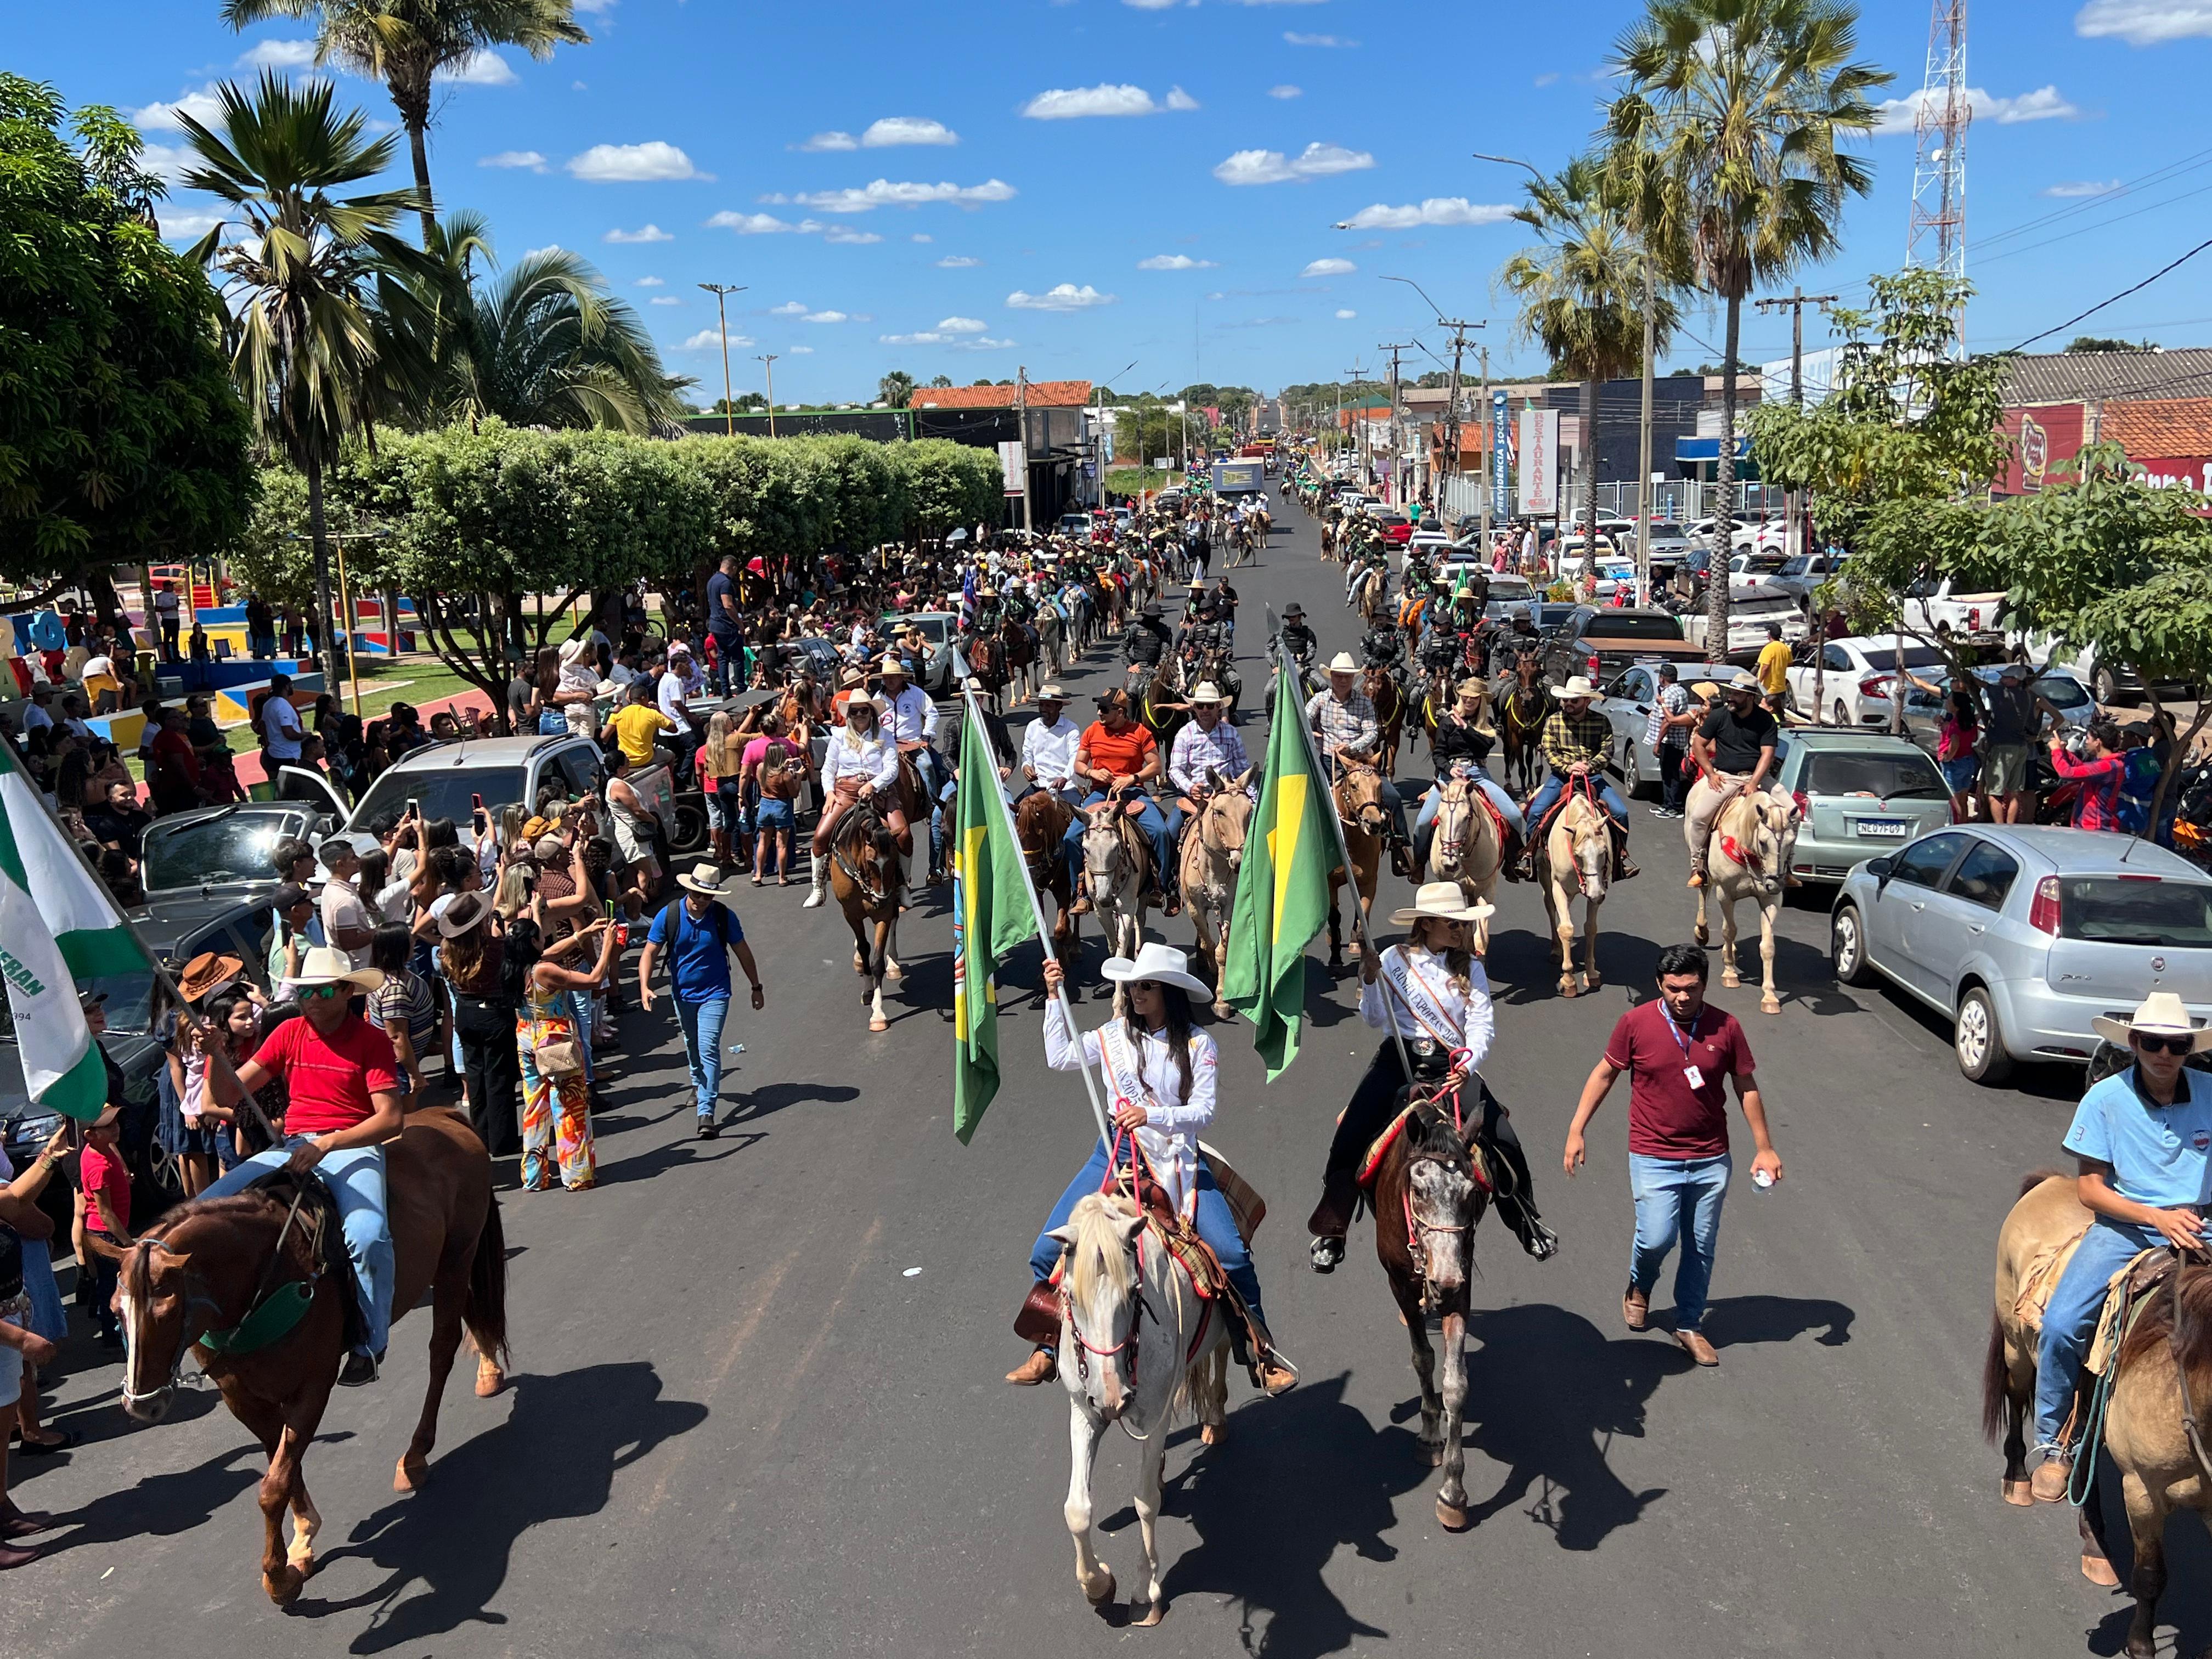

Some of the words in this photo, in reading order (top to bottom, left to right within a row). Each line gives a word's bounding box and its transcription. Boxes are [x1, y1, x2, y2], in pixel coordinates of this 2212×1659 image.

[1533, 411, 1544, 498] RESTAURANTE
[1392, 966, 1416, 997] RAINHA
[1411, 993, 1443, 1032] EXPOFRAN
[1122, 1079, 1142, 1106] 2025
